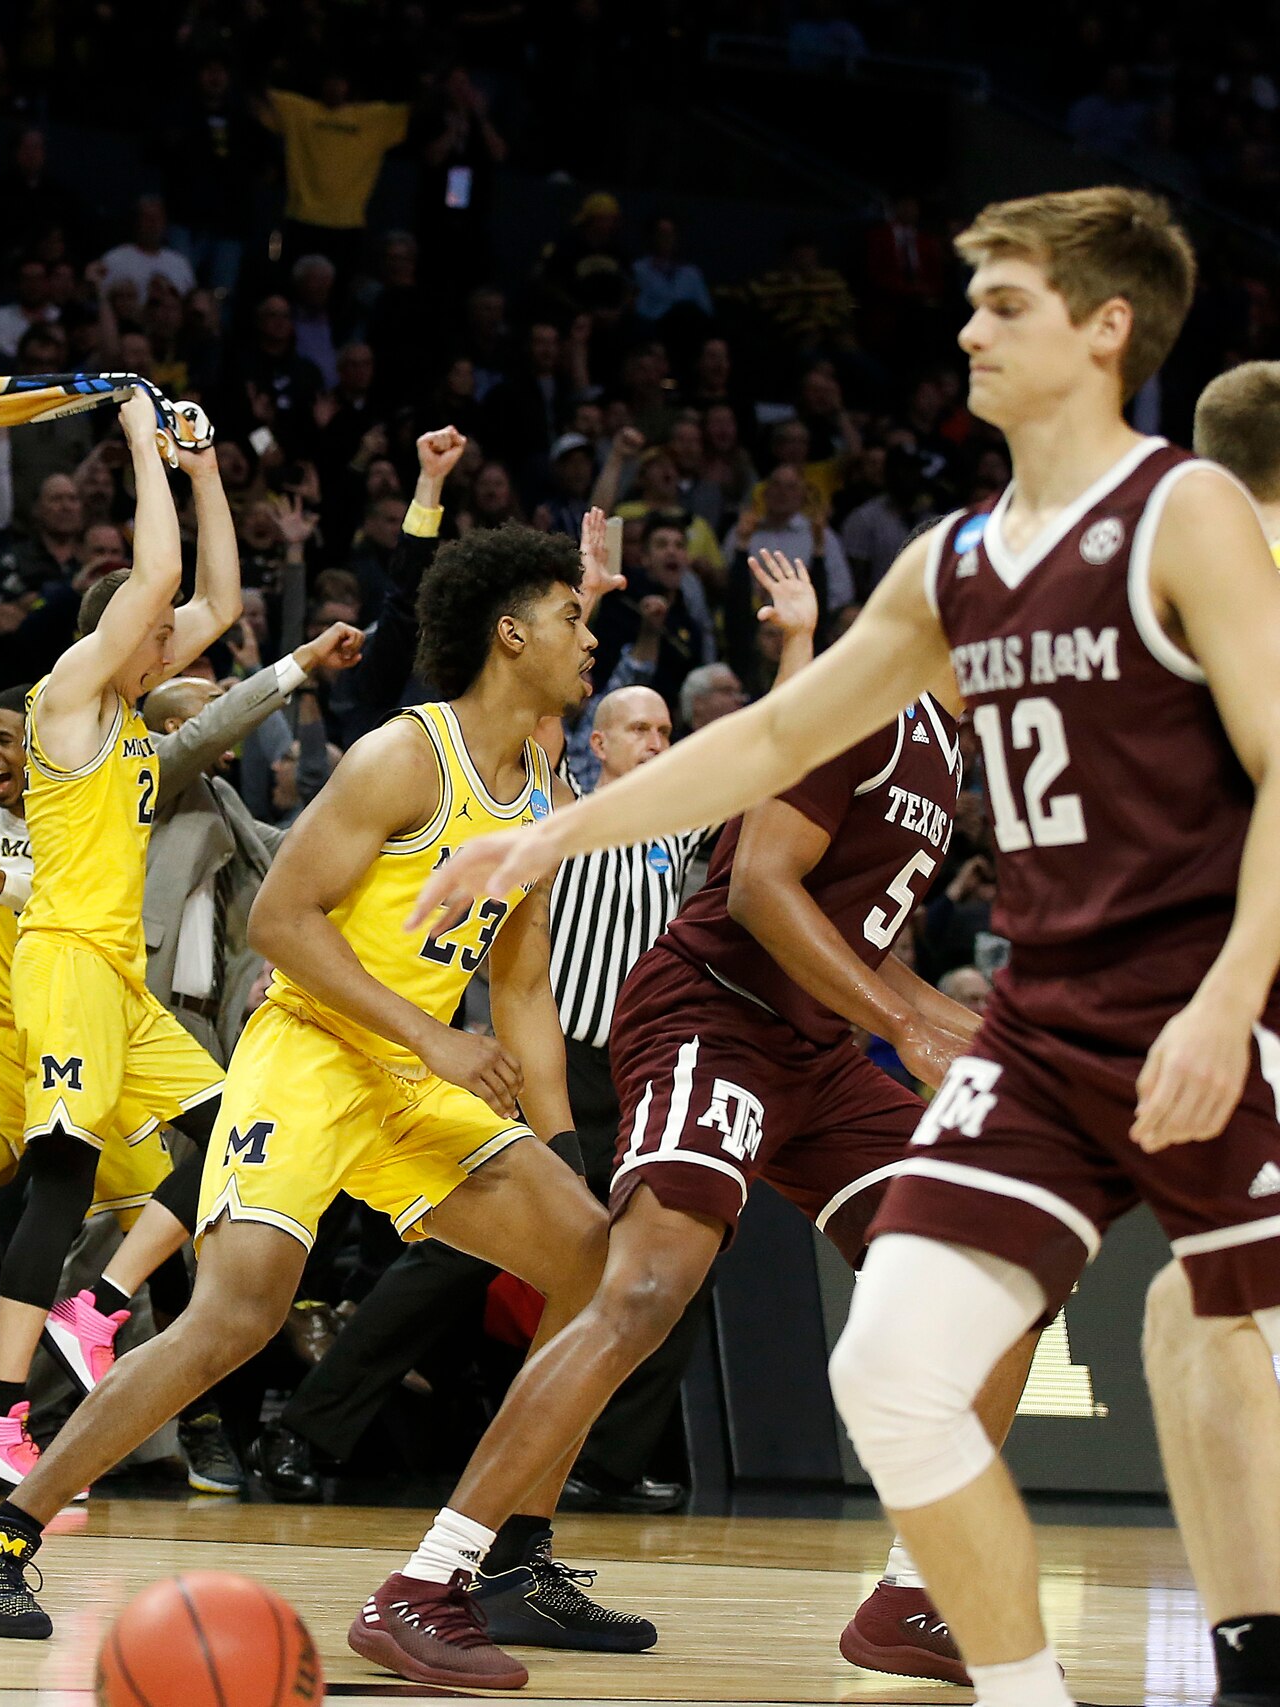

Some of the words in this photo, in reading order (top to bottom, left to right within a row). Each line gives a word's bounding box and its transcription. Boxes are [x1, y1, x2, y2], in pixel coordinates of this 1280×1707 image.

[949, 634, 1025, 697] EXAS
[1030, 627, 1120, 684] A&M
[137, 769, 154, 824] 2
[973, 697, 1088, 853] 12
[884, 785, 947, 848] TEXAS
[863, 849, 937, 950] 5
[420, 897, 509, 972] 23
[41, 1055, 83, 1091] M
[223, 1121, 274, 1167] M
